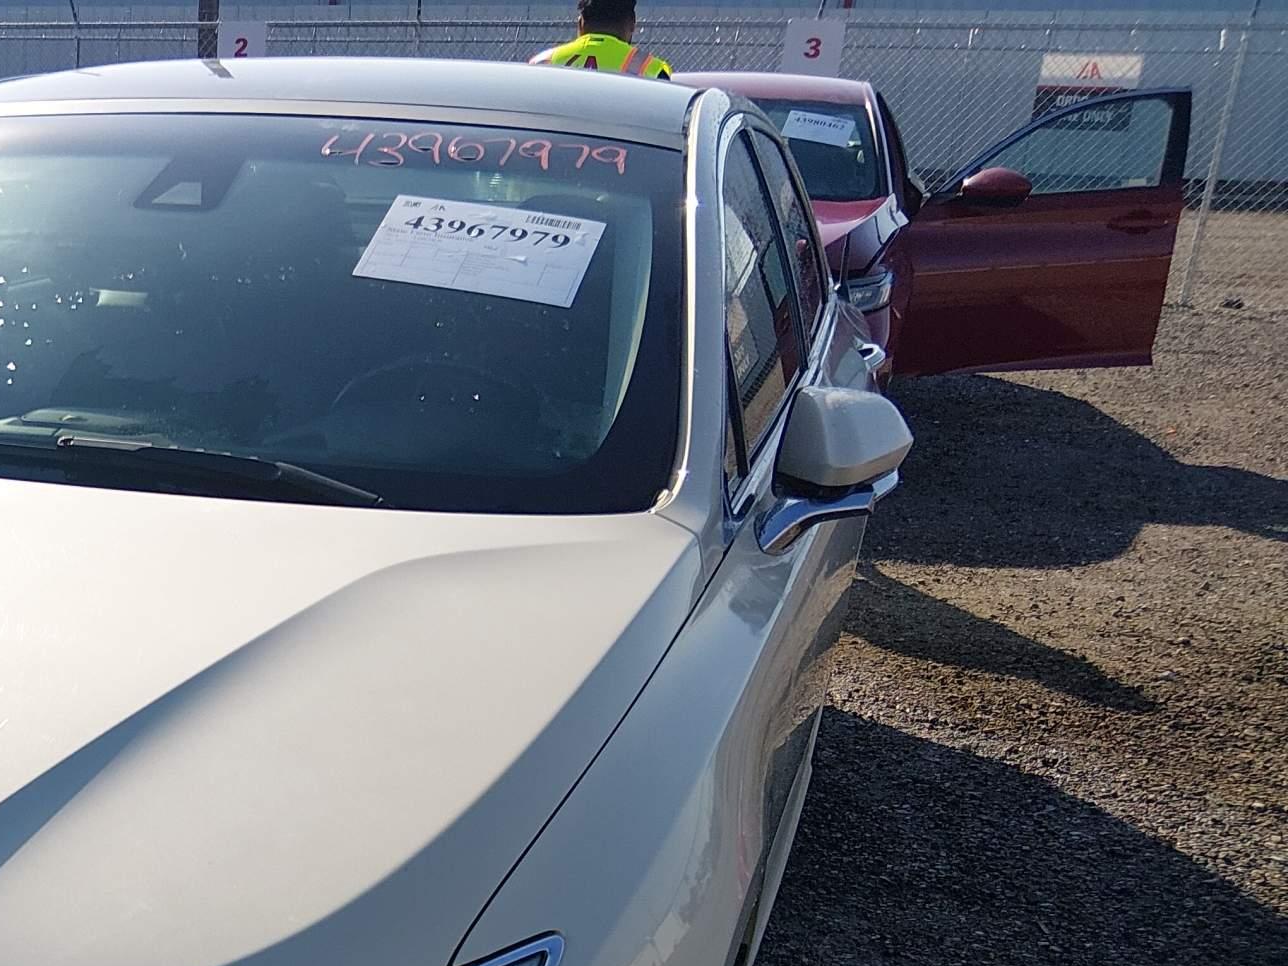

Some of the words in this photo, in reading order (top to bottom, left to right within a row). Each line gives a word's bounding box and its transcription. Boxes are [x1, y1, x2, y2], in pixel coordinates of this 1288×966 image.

[234, 38, 249, 58] 2
[803, 37, 822, 59] 3
[321, 132, 628, 175] 43967979
[404, 214, 571, 249] 43967979
